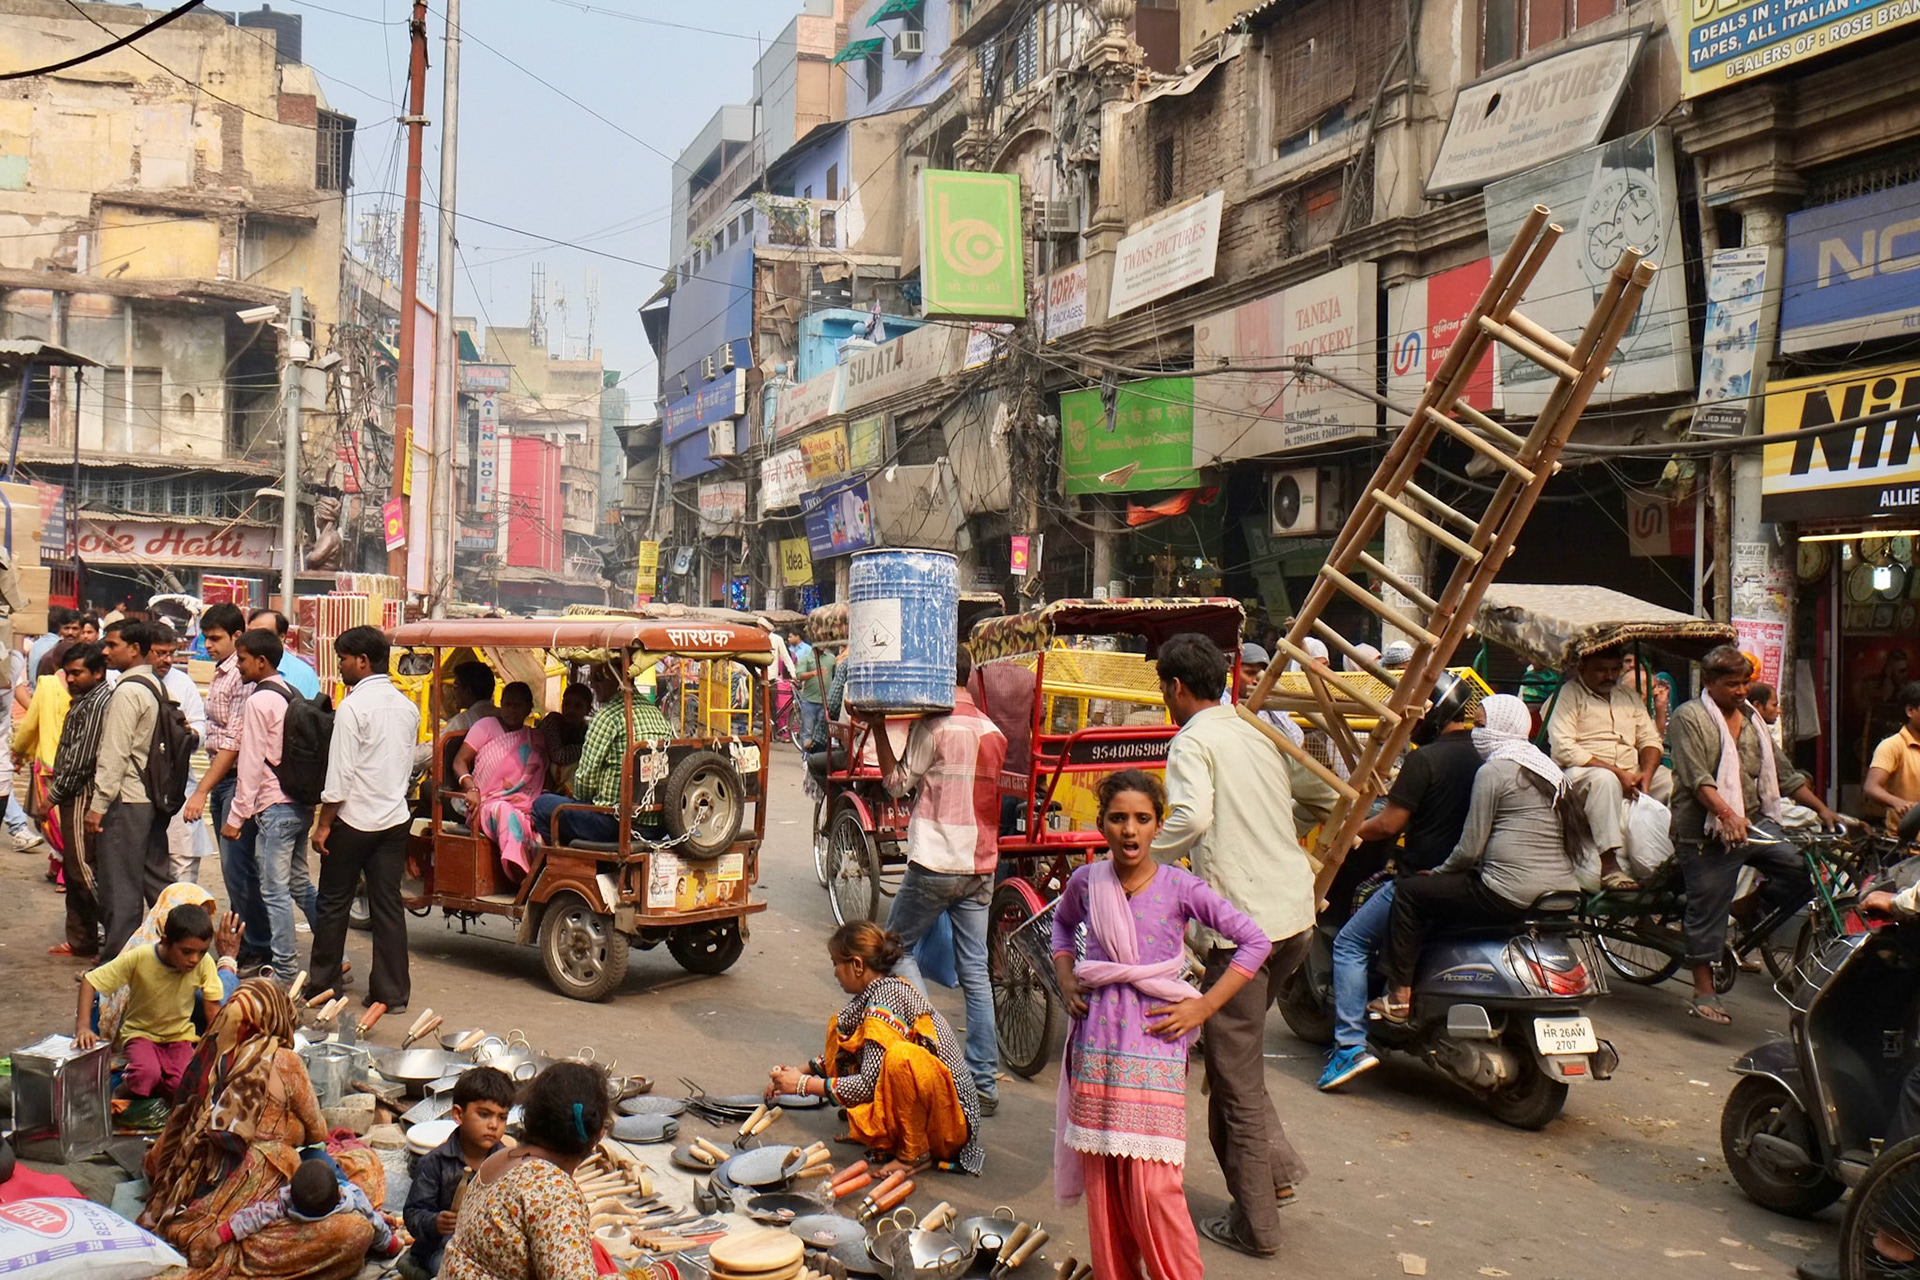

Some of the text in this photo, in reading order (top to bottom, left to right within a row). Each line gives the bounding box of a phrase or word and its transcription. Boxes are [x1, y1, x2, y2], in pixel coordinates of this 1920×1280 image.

[1692, 36, 1742, 64] TAPES,
[1747, 22, 1777, 44] ALL
[1782, 0, 1849, 31] ITALIAN
[1700, 13, 1747, 43] DEALS
[1752, 5, 1769, 22] IN
[1726, 43, 1790, 79] DEALERS
[1795, 34, 1816, 52] OF
[1829, 14, 1872, 43] ROSE
[1513, 55, 1626, 122] PICTURES
[1122, 244, 1153, 273] TWINS
[1153, 220, 1207, 259] PICTURES
[1049, 272, 1076, 308] CORP.
[1052, 304, 1083, 325] PACKAGES
[1296, 296, 1342, 331] TANEJA
[1285, 326, 1354, 366] CROCKERY
[849, 345, 902, 388] SUJATA
[1720, 415, 1742, 424] SALES
[1880, 487, 1920, 507] ALLIE
[144, 526, 243, 558] Hatti
[665, 629, 730, 648] सारथक
[887, 805, 911, 820] RAM
[1443, 973, 1494, 982] Access 125
[1543, 1027, 1586, 1038] HR 26AW
[1556, 1041, 1576, 1050] 2707
